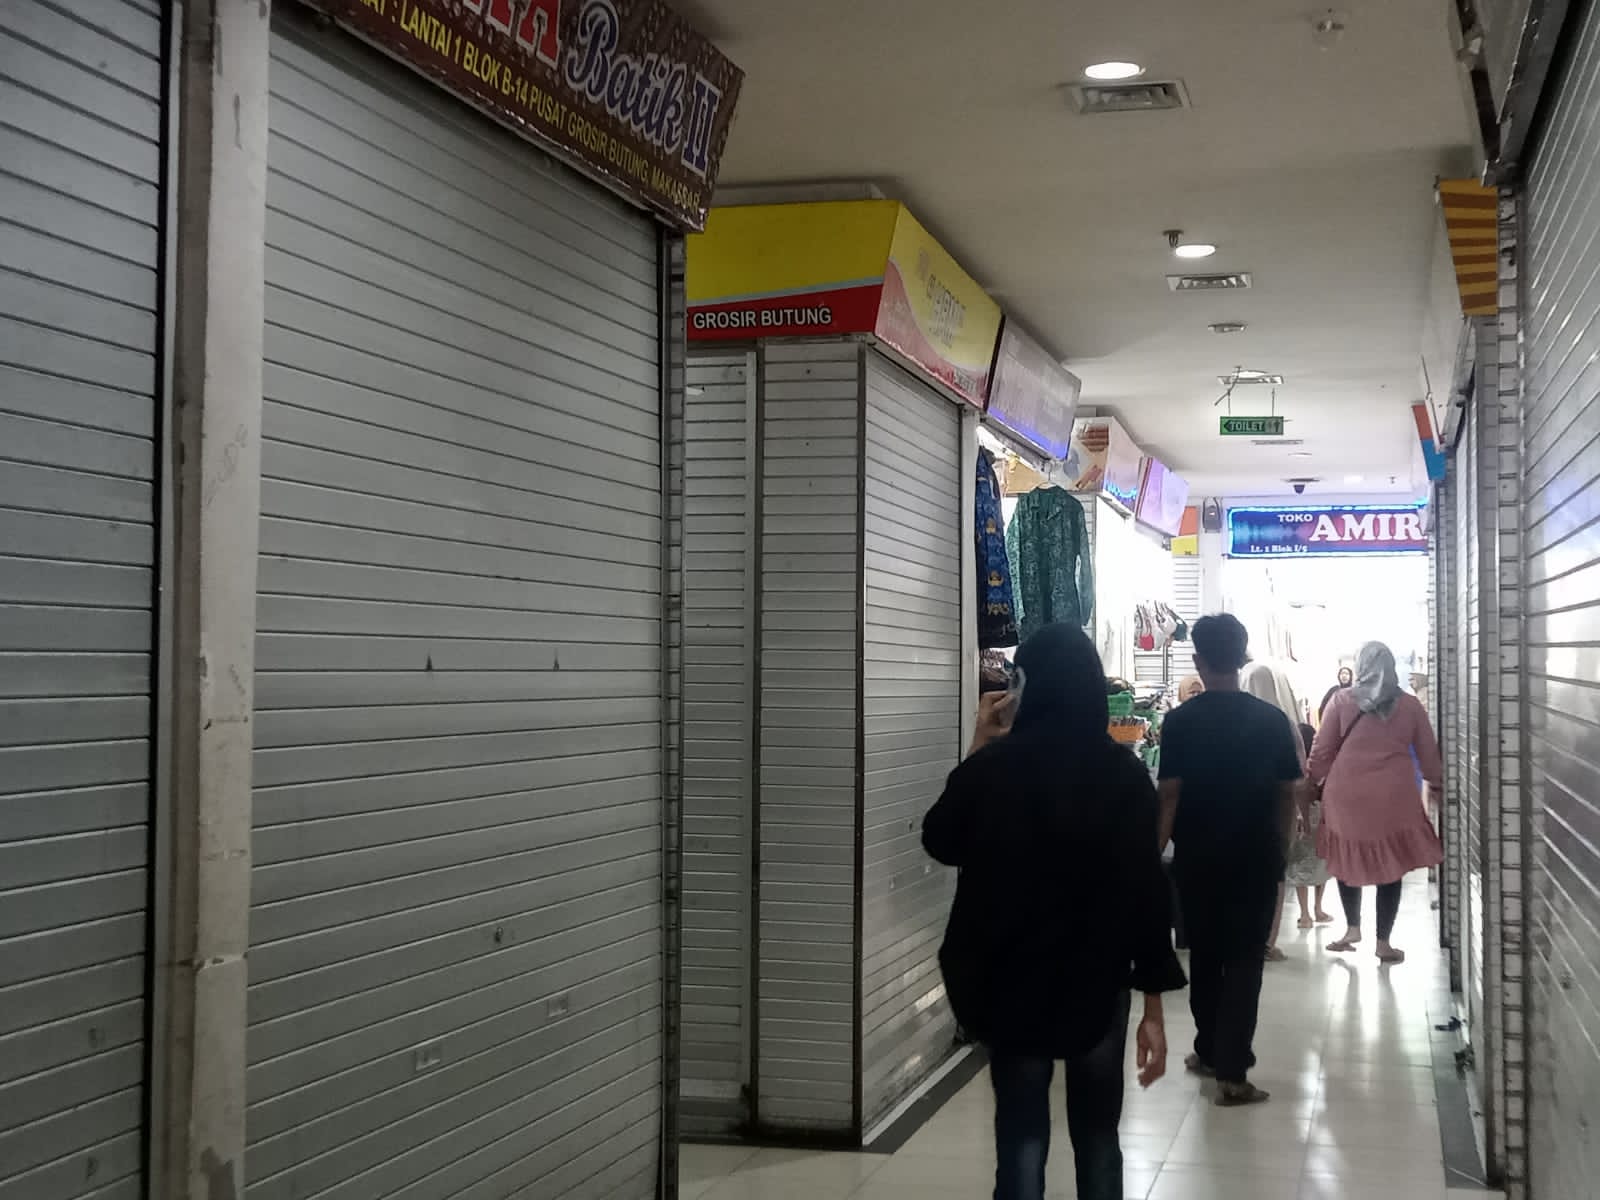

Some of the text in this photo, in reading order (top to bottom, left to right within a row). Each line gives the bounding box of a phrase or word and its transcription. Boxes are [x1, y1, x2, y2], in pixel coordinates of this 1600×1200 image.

[566, 0, 686, 154] Batik
[400, 0, 452, 57] LANTAI
[463, 41, 501, 89] BLOK
[501, 65, 530, 105] B-14
[529, 86, 569, 132] PUSAT
[568, 112, 608, 157] GROSIR
[652, 165, 701, 215] MAKASSAR
[693, 307, 832, 329] GROSIR BUTUNG
[1231, 421, 1265, 432] TOILET
[1277, 514, 1314, 523] TOKO
[1309, 513, 1427, 542] AMIR
